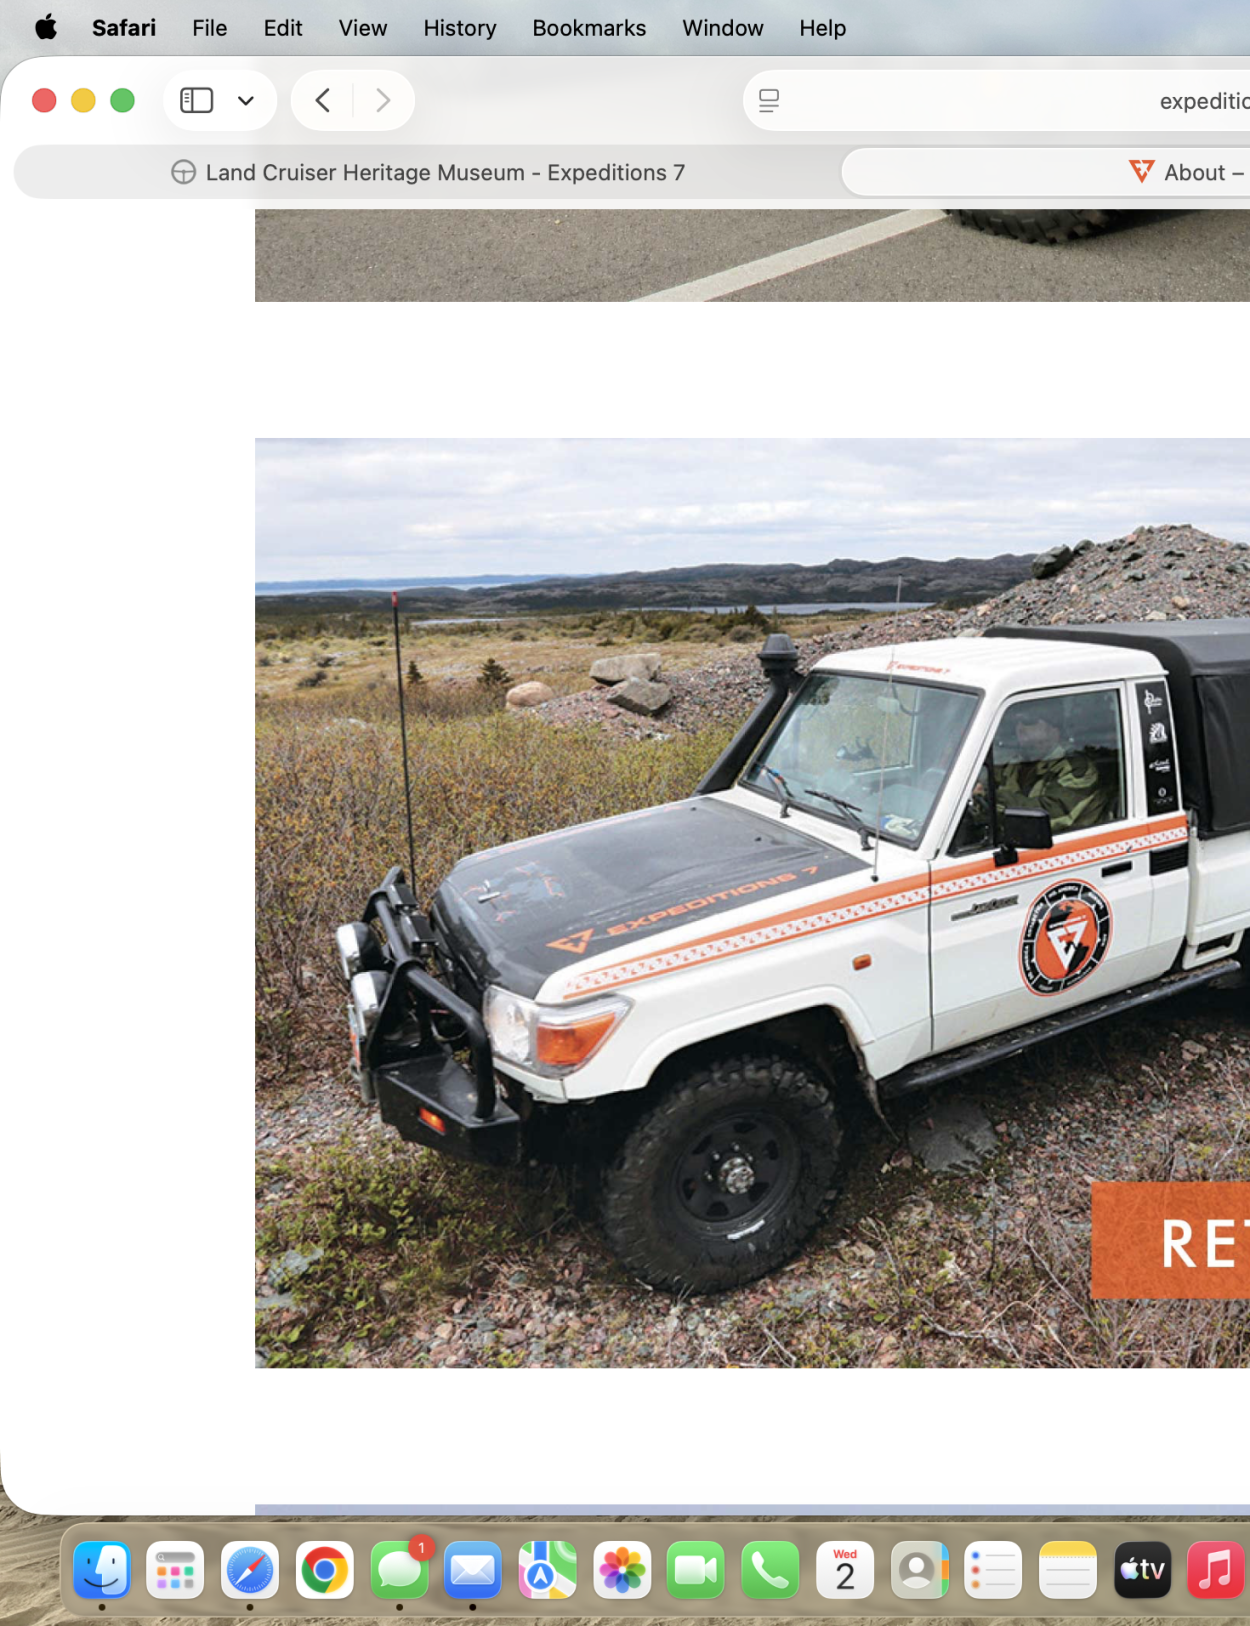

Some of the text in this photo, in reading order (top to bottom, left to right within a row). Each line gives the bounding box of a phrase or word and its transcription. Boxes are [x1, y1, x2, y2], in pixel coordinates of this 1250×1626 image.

[92, 17, 847, 41] Safari File Edit View History Bookmarks Window Help
[206, 163, 256, 182] Land
[262, 163, 337, 182] Cruiser
[343, 162, 431, 186] Heritage
[438, 163, 525, 182] Museum
[548, 163, 667, 185] Expeditions
[673, 163, 686, 181] 7
[1164, 163, 1226, 182] About
[606, 865, 819, 936] EXPEDITIONS 7
[418, 1542, 424, 1554] 1
[833, 1549, 858, 1560] Wed
[836, 1562, 855, 1590] 2
[1140, 1558, 1166, 1580] tv
